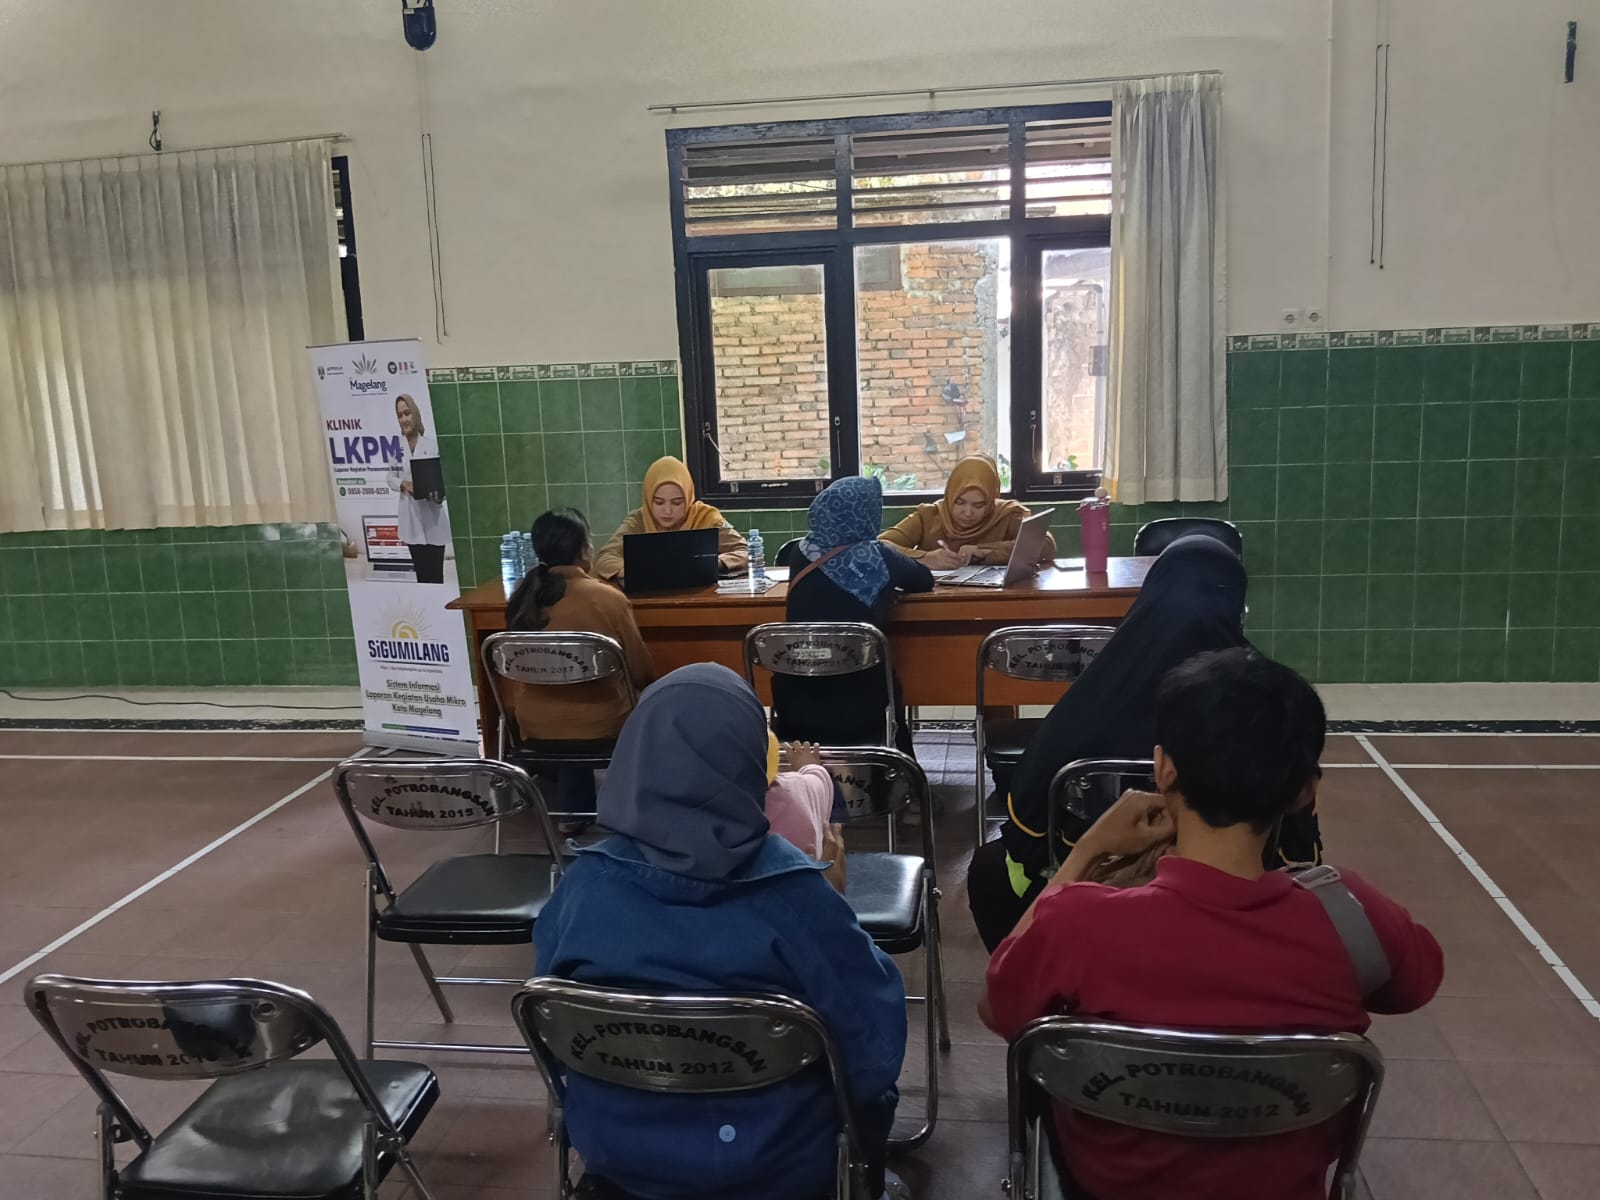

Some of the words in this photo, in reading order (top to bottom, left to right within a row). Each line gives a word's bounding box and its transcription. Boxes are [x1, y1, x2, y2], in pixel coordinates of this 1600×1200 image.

[350, 379, 388, 392] Magelang
[326, 418, 362, 431] KLINIK
[329, 435, 403, 464] LKPM
[368, 640, 449, 662] SiGUMILANG
[386, 680, 408, 689] Sistem
[409, 681, 440, 691] Informasi
[365, 690, 392, 702] Laporan
[393, 692, 423, 702] Kegiatan
[424, 694, 445, 703] Usaha
[446, 696, 466, 705] Mikro
[392, 704, 406, 712] Kota
[409, 704, 441, 717] Magelang
[384, 783, 496, 817] POTROBANGSAN
[386, 806, 435, 818] TAHUN
[94, 1048, 163, 1067] TAHUN
[593, 1021, 768, 1075] POTROBANGSAN
[595, 1051, 674, 1074] TAHUN
[681, 1061, 736, 1075] 2012
[1125, 1062, 1311, 1117] POTROBANGSAN
[1118, 1091, 1211, 1117] TAHUN
[1219, 1103, 1280, 1119] 2012
